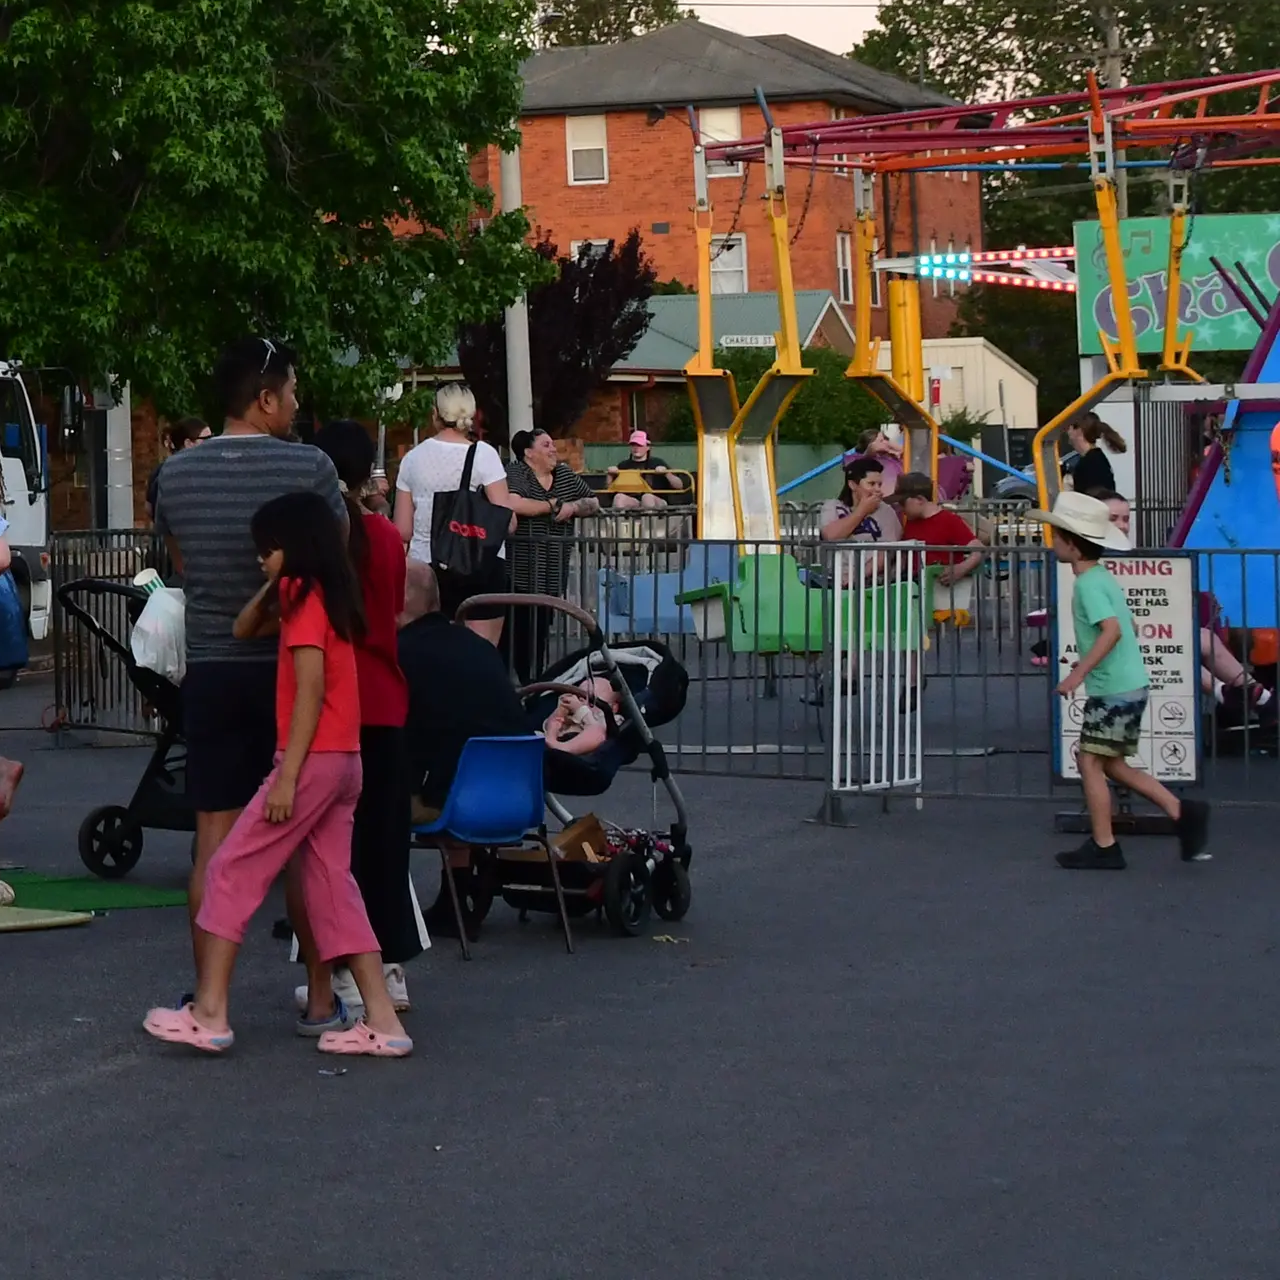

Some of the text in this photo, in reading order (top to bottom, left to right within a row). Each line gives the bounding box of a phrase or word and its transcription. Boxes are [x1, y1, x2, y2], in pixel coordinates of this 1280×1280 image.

[725, 336, 772, 345] CHARLES ST
[1104, 560, 1173, 576] RNING
[1128, 588, 1166, 597] ENTER
[1126, 598, 1169, 607] DE HAS
[1155, 645, 1184, 654] RIDE
[1143, 657, 1164, 665] ISK
